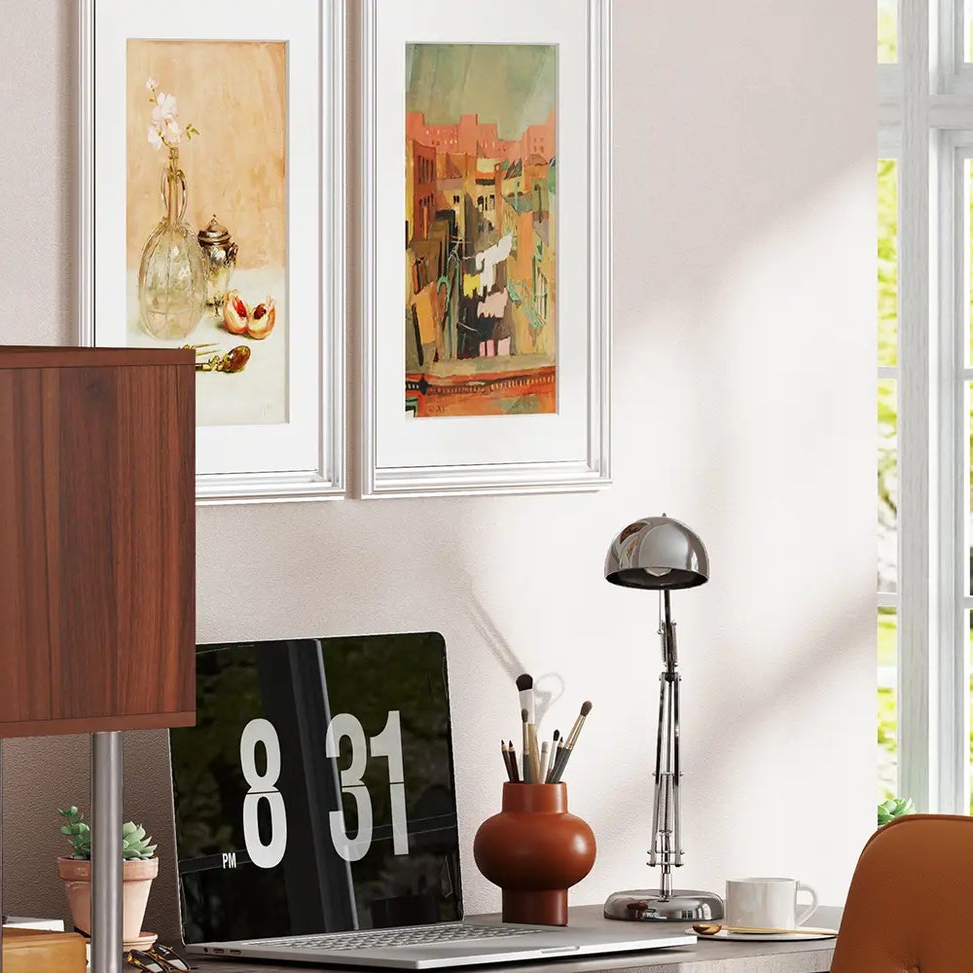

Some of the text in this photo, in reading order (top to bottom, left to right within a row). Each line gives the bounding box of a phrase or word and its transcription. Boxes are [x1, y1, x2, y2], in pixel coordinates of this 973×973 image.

[240, 710, 409, 869] 8 31
[222, 852, 237, 869] PM
